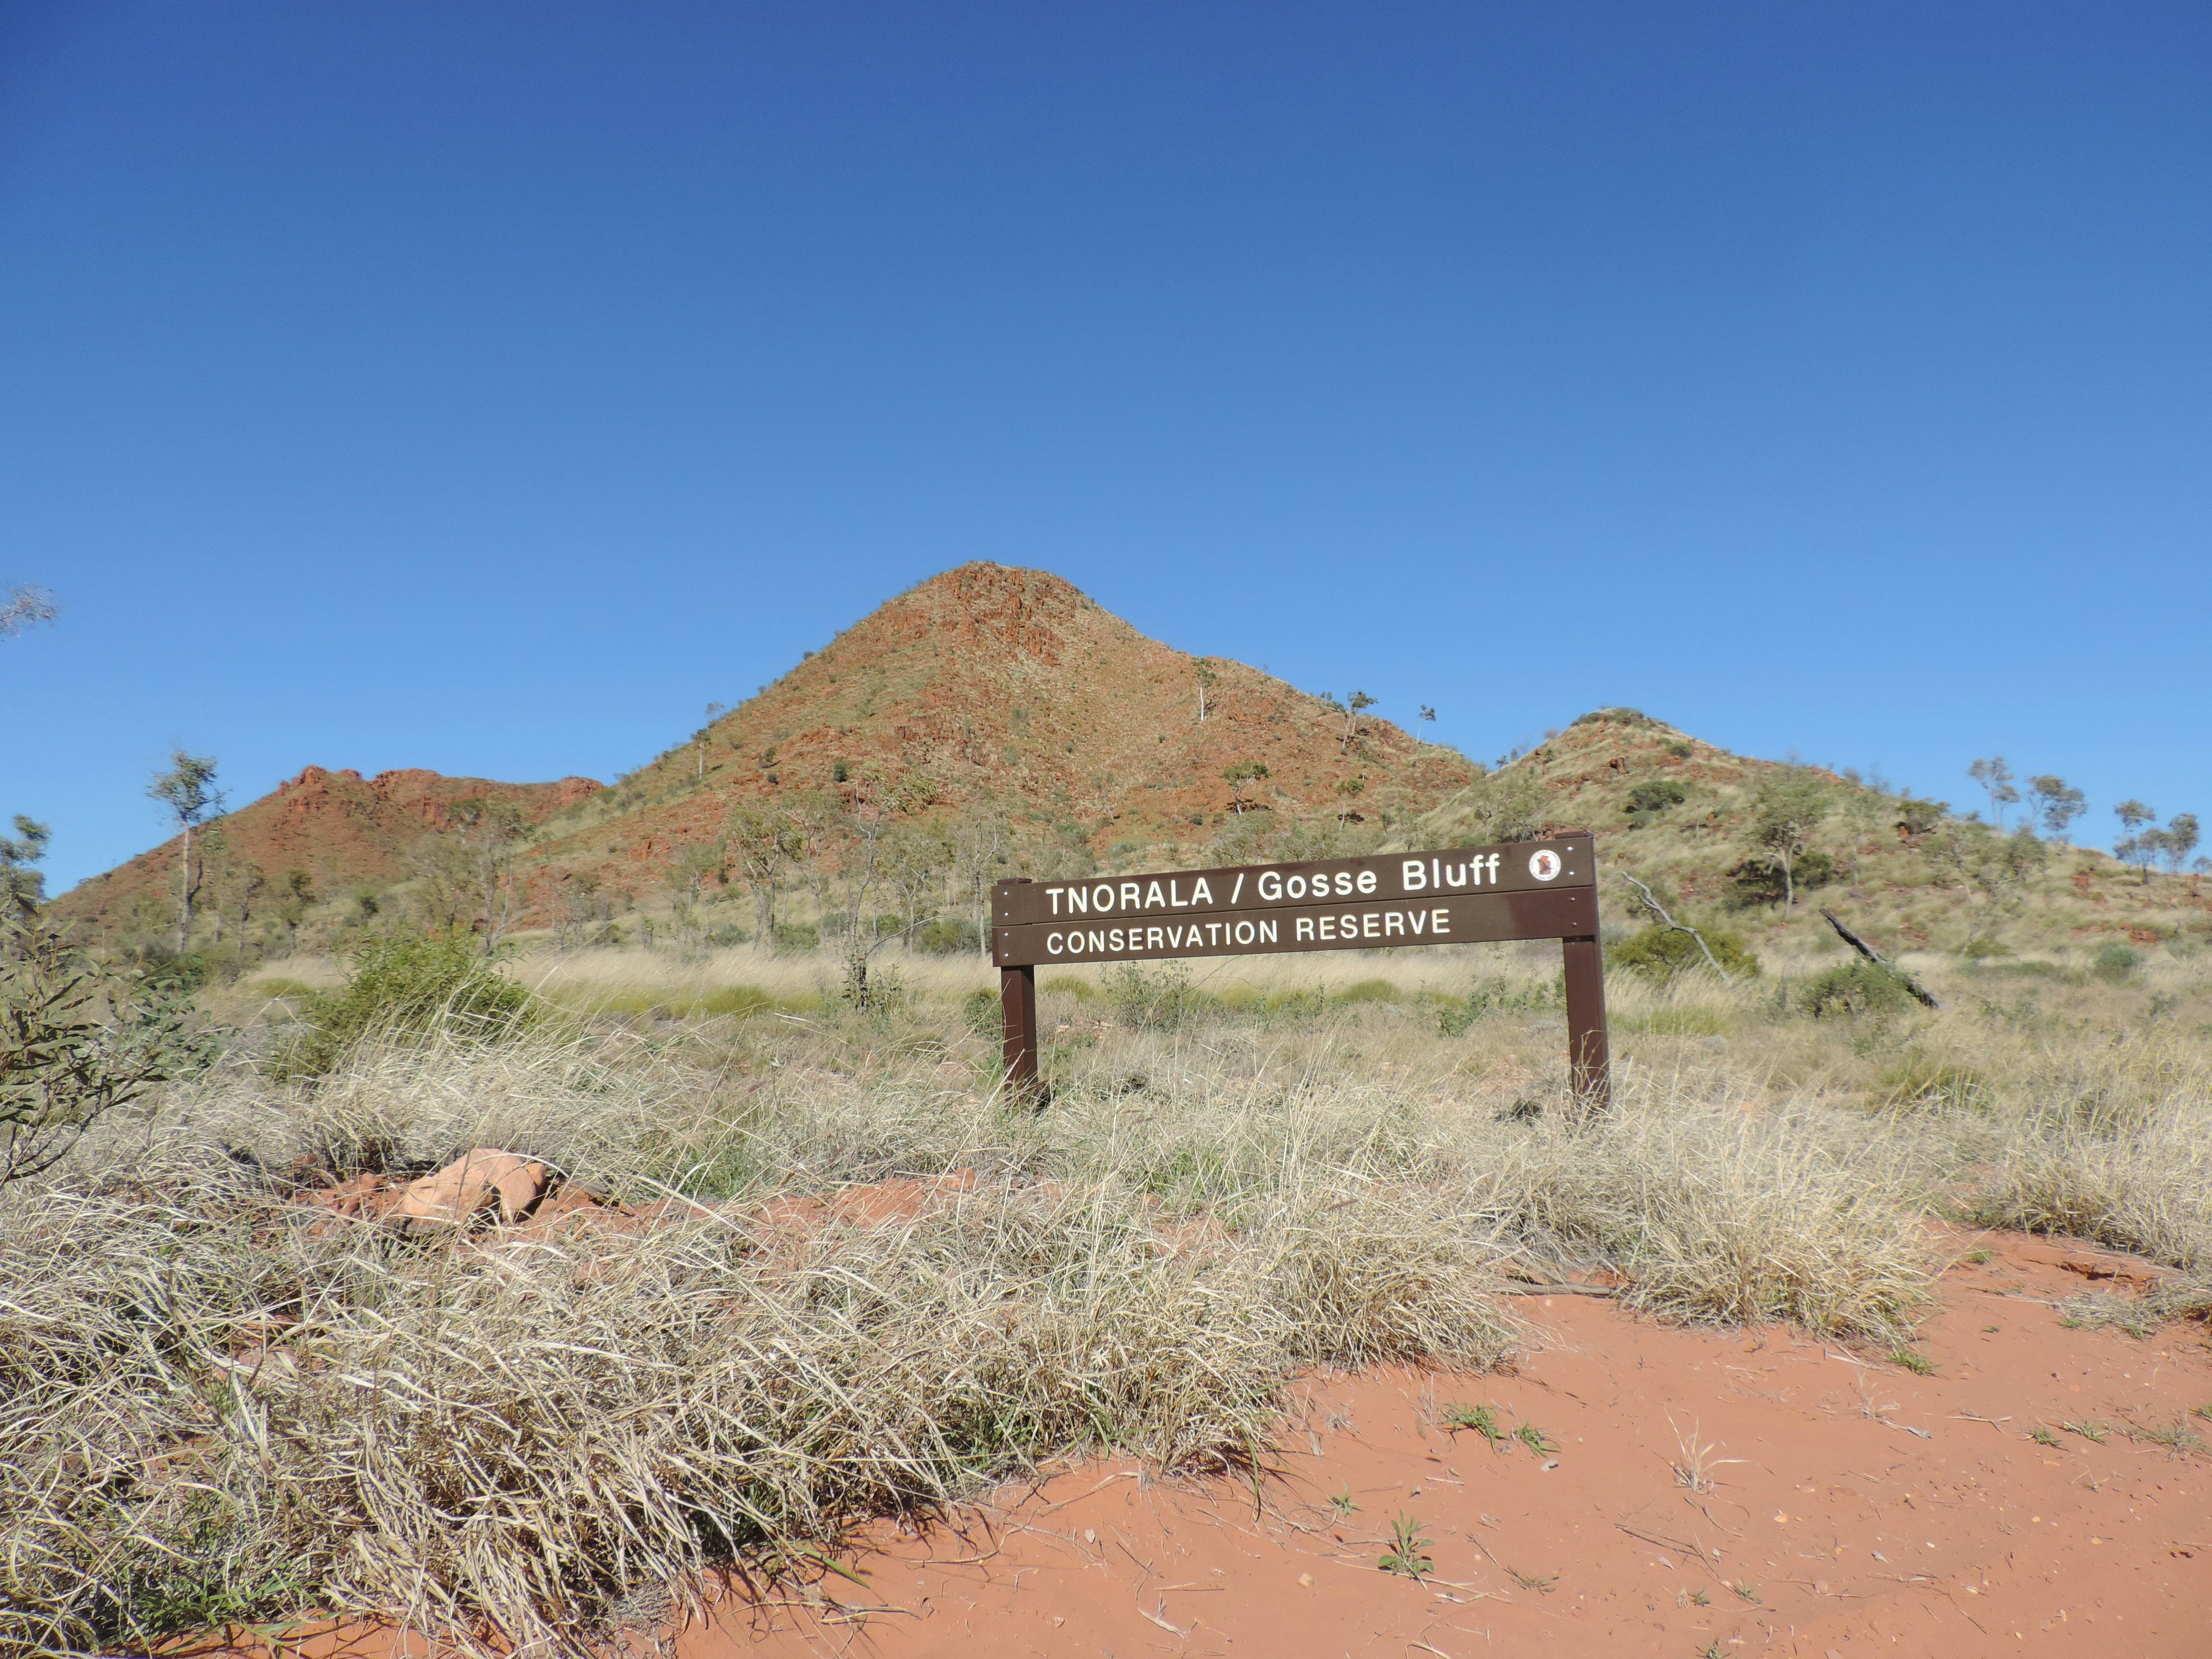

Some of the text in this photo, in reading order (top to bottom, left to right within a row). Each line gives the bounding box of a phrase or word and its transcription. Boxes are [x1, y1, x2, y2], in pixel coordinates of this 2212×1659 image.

[1045, 877, 1214, 915] TNORALA
[1231, 873, 1244, 904] /
[1258, 870, 1377, 901] Gosse
[1402, 853, 1500, 890] Bluff
[1047, 909, 1451, 955] CONSERVATION RESERVE
